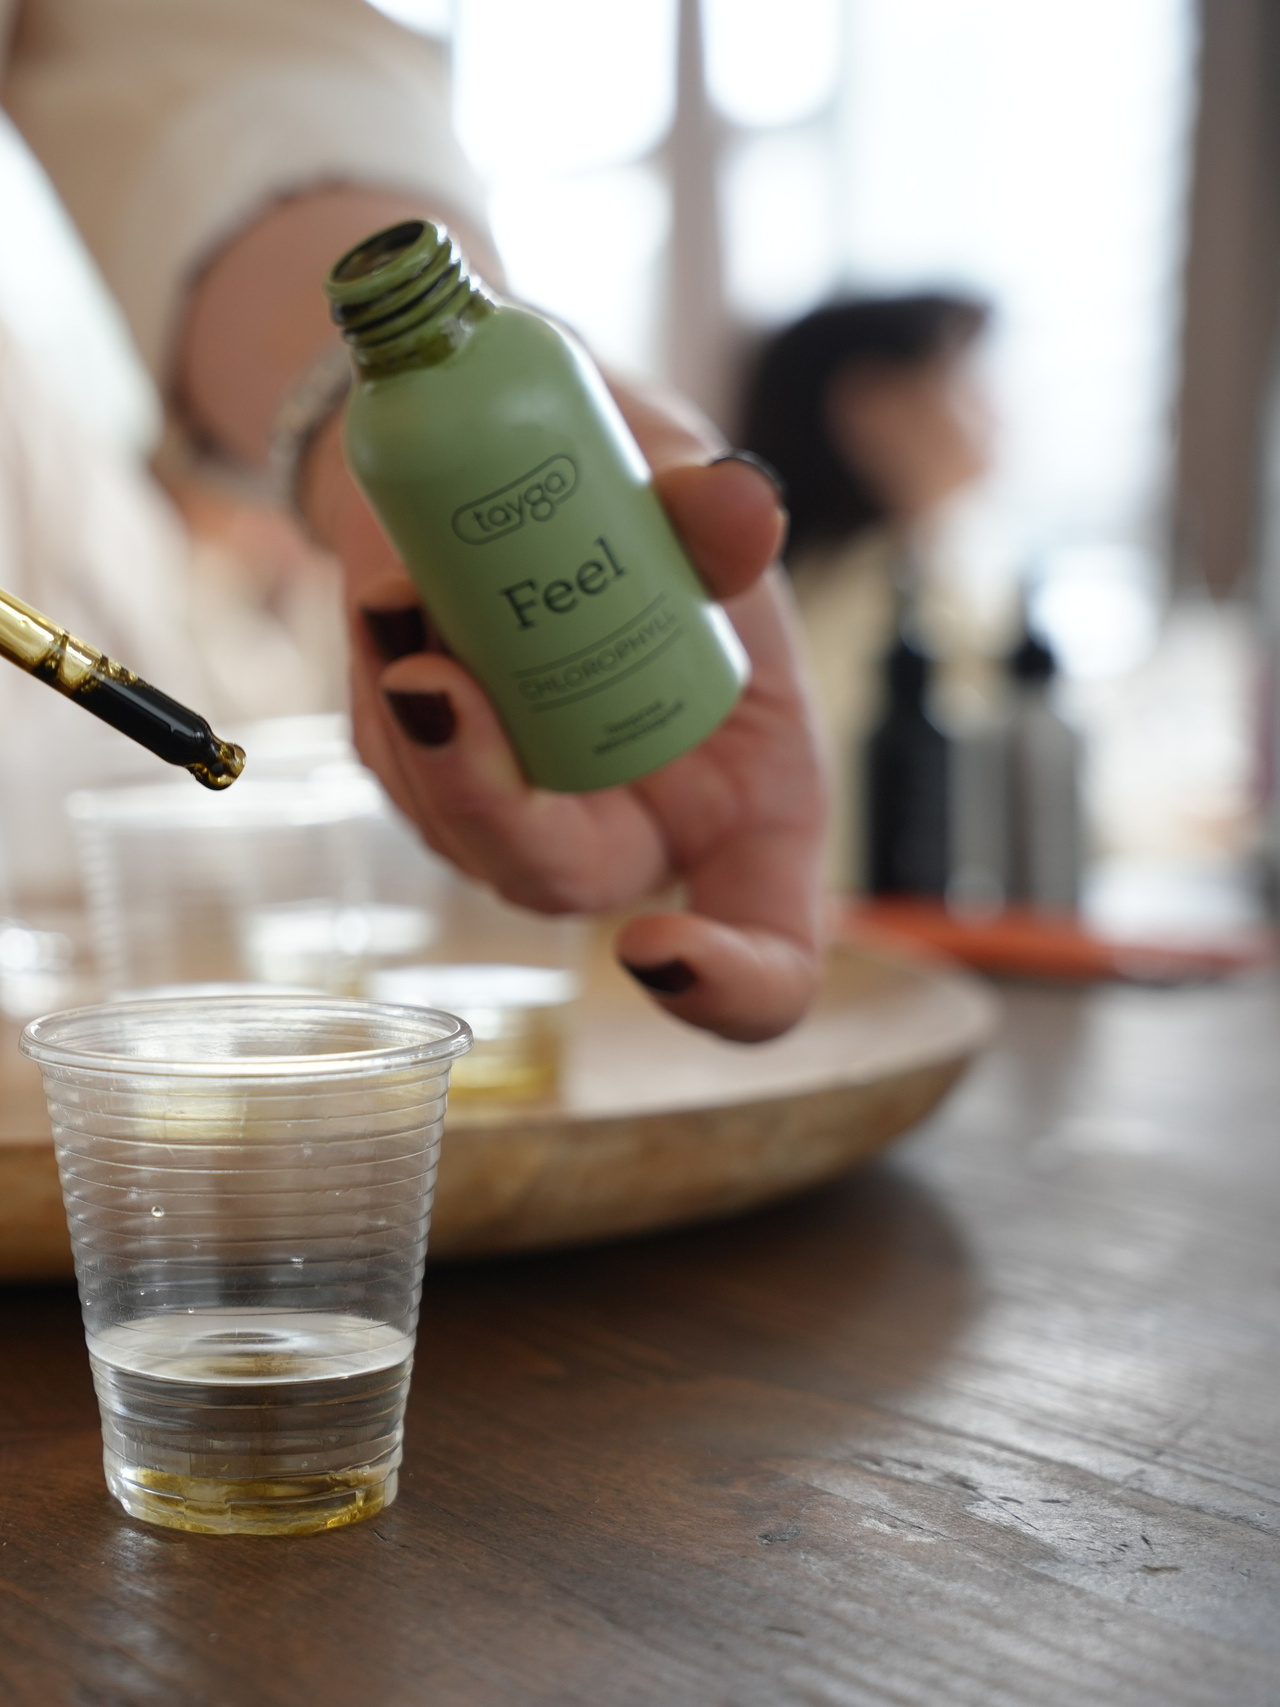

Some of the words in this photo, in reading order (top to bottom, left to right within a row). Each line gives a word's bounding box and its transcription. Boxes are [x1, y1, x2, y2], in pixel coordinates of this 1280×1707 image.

[472, 470, 567, 533] tayga
[499, 535, 629, 632] Feel
[520, 608, 677, 697] CHLOROPHYLL
